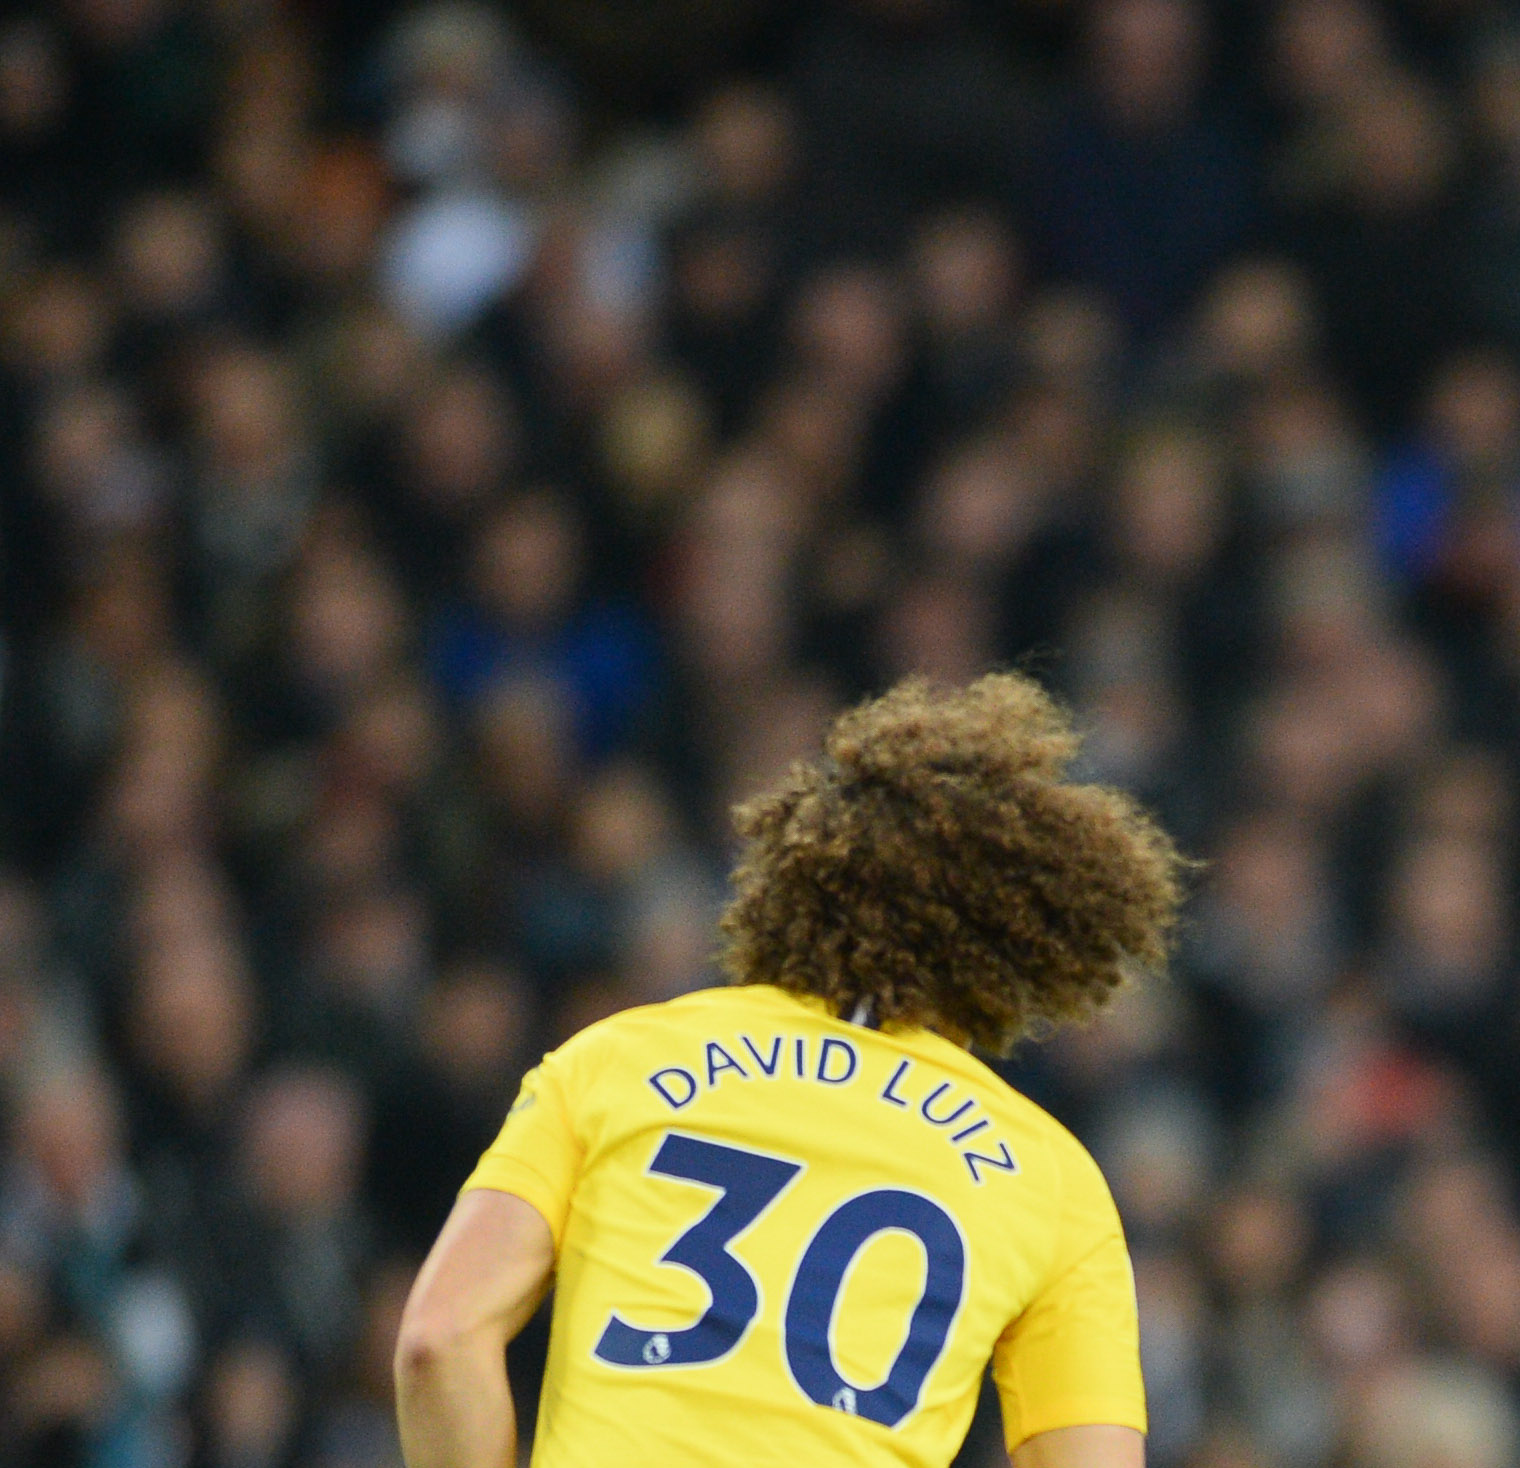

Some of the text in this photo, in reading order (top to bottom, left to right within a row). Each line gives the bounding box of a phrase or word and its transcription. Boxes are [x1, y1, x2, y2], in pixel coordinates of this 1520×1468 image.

[648, 1035, 1017, 1184] DAVID LUIZ
[592, 1131, 968, 1431] 30
